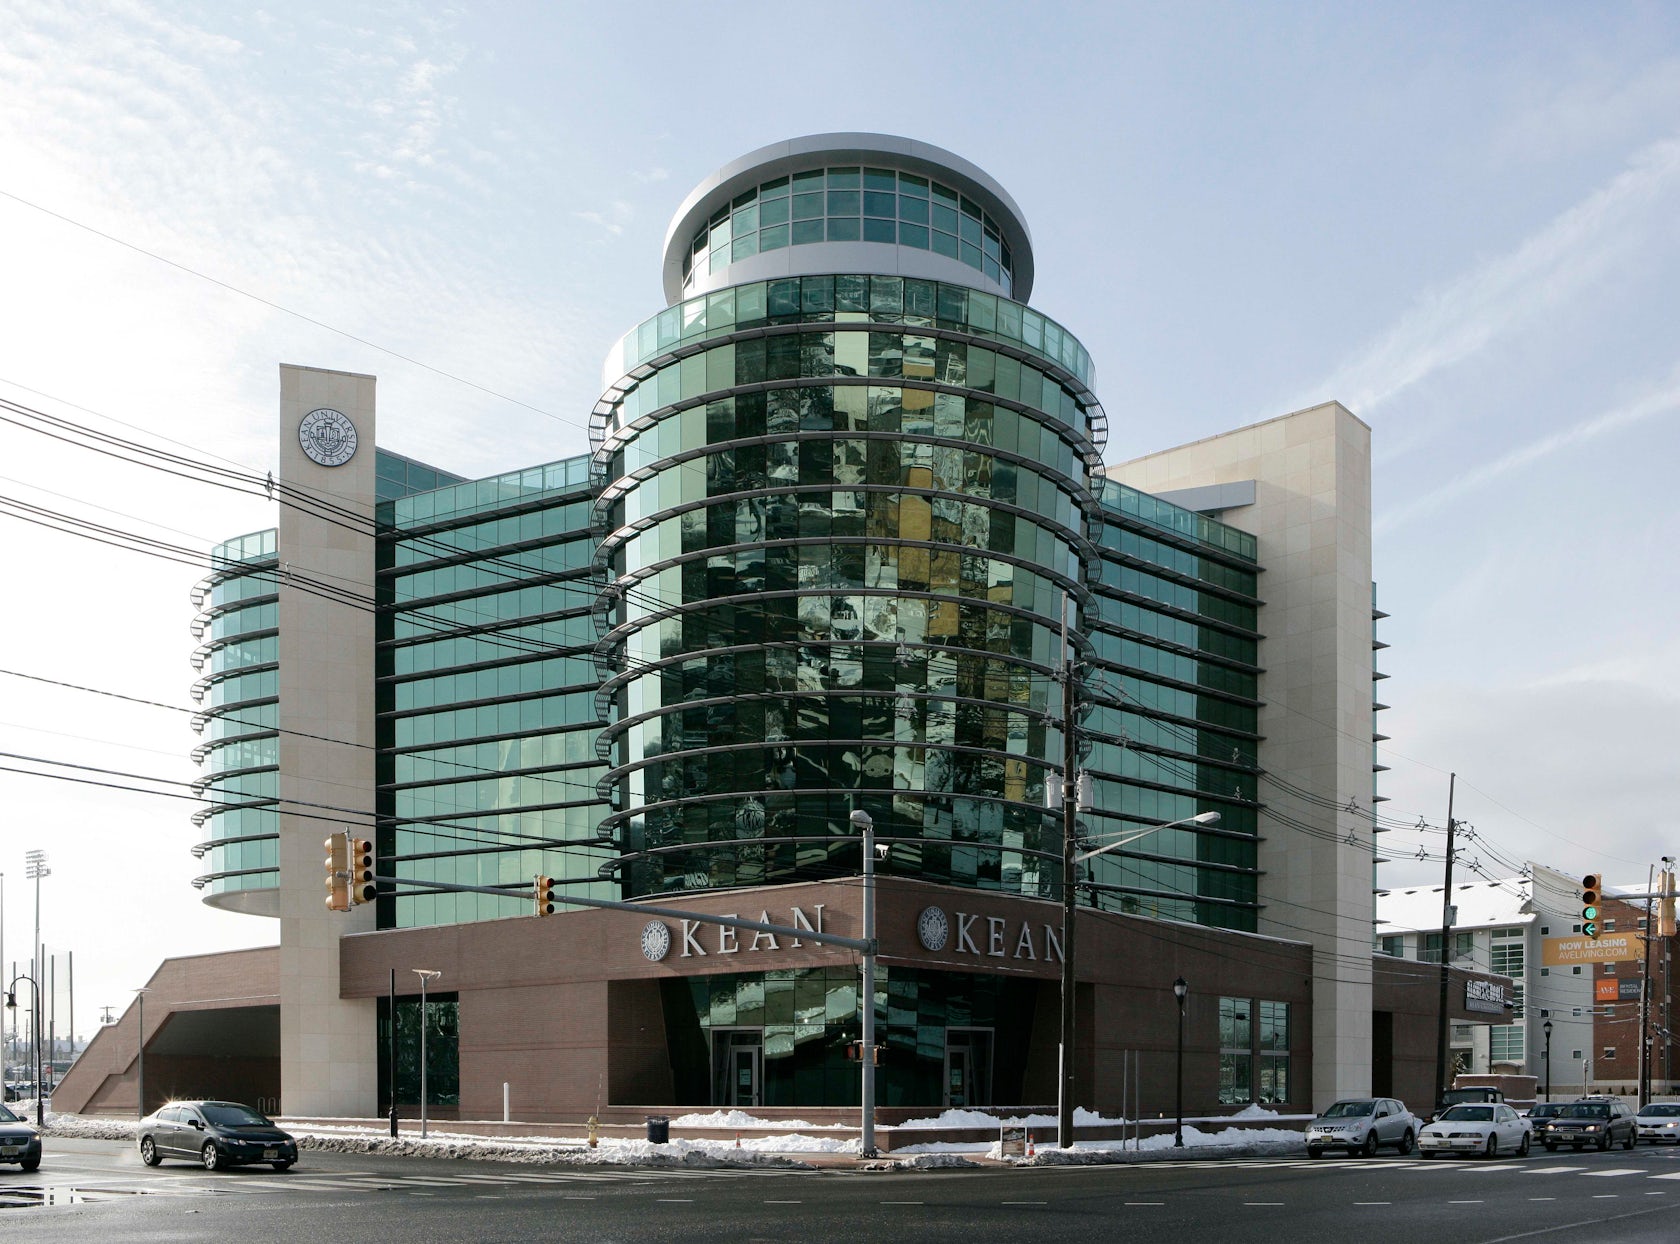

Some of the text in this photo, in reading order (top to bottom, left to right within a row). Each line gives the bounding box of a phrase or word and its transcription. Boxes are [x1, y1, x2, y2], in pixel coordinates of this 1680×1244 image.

[312, 411, 356, 457] UNIVERSITY
[680, 904, 825, 957] KEAN
[955, 912, 1065, 963] KEAN
[1558, 948, 1628, 959] AVELIVING.COM
[1559, 938, 1627, 951] NOW LEASING
